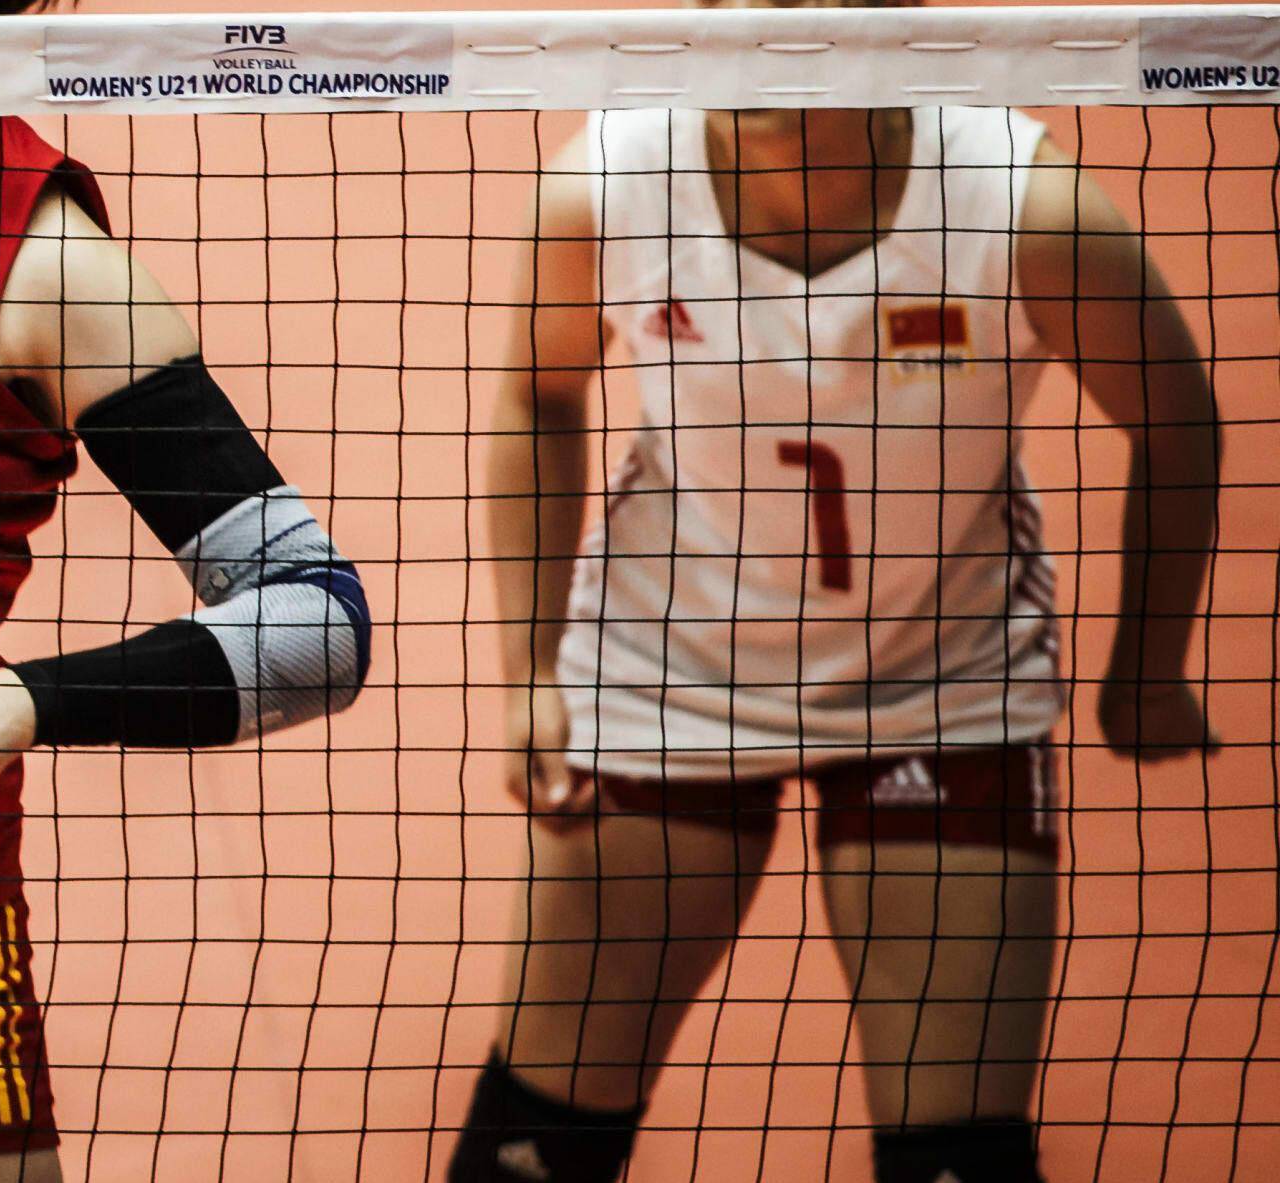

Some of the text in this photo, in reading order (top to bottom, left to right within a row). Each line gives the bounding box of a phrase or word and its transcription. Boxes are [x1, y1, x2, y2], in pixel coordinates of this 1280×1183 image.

[213, 58, 297, 70] VOLLEYBALL
[48, 73, 450, 98] WOMEN'S U21 WORLD CHAMPIONSHIP
[1142, 65, 1247, 90] WOMEN'S
